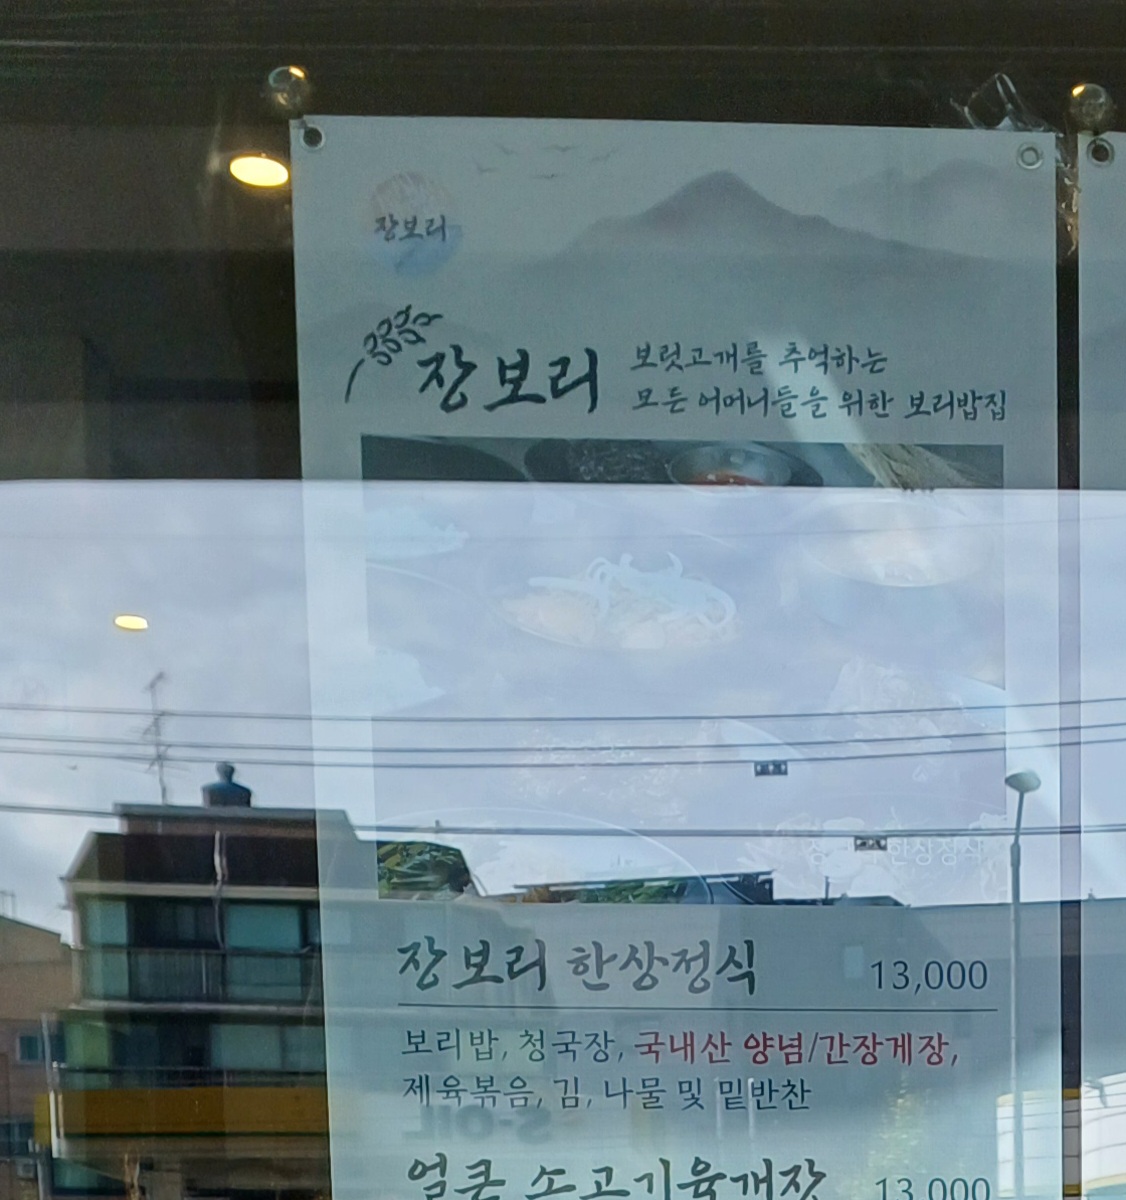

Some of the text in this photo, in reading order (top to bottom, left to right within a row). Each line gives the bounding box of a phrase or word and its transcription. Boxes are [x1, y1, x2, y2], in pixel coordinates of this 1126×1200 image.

[374, 214, 449, 242] 장보리
[778, 339, 888, 375] 추억하는
[415, 346, 601, 414] 장보리
[631, 386, 1006, 421] 모든 어머니들을 위한 보리밥집
[399, 936, 988, 995] 장보리 한상정식 13,000
[401, 1028, 958, 1068] 보리밥, 청국장, 국내산 양념/간장게장,
[402, 1075, 542, 1109] 제육볶음,
[554, 1076, 592, 1109] 김,
[602, 1078, 668, 1109] 나물
[719, 1078, 811, 1111] 밑반찬
